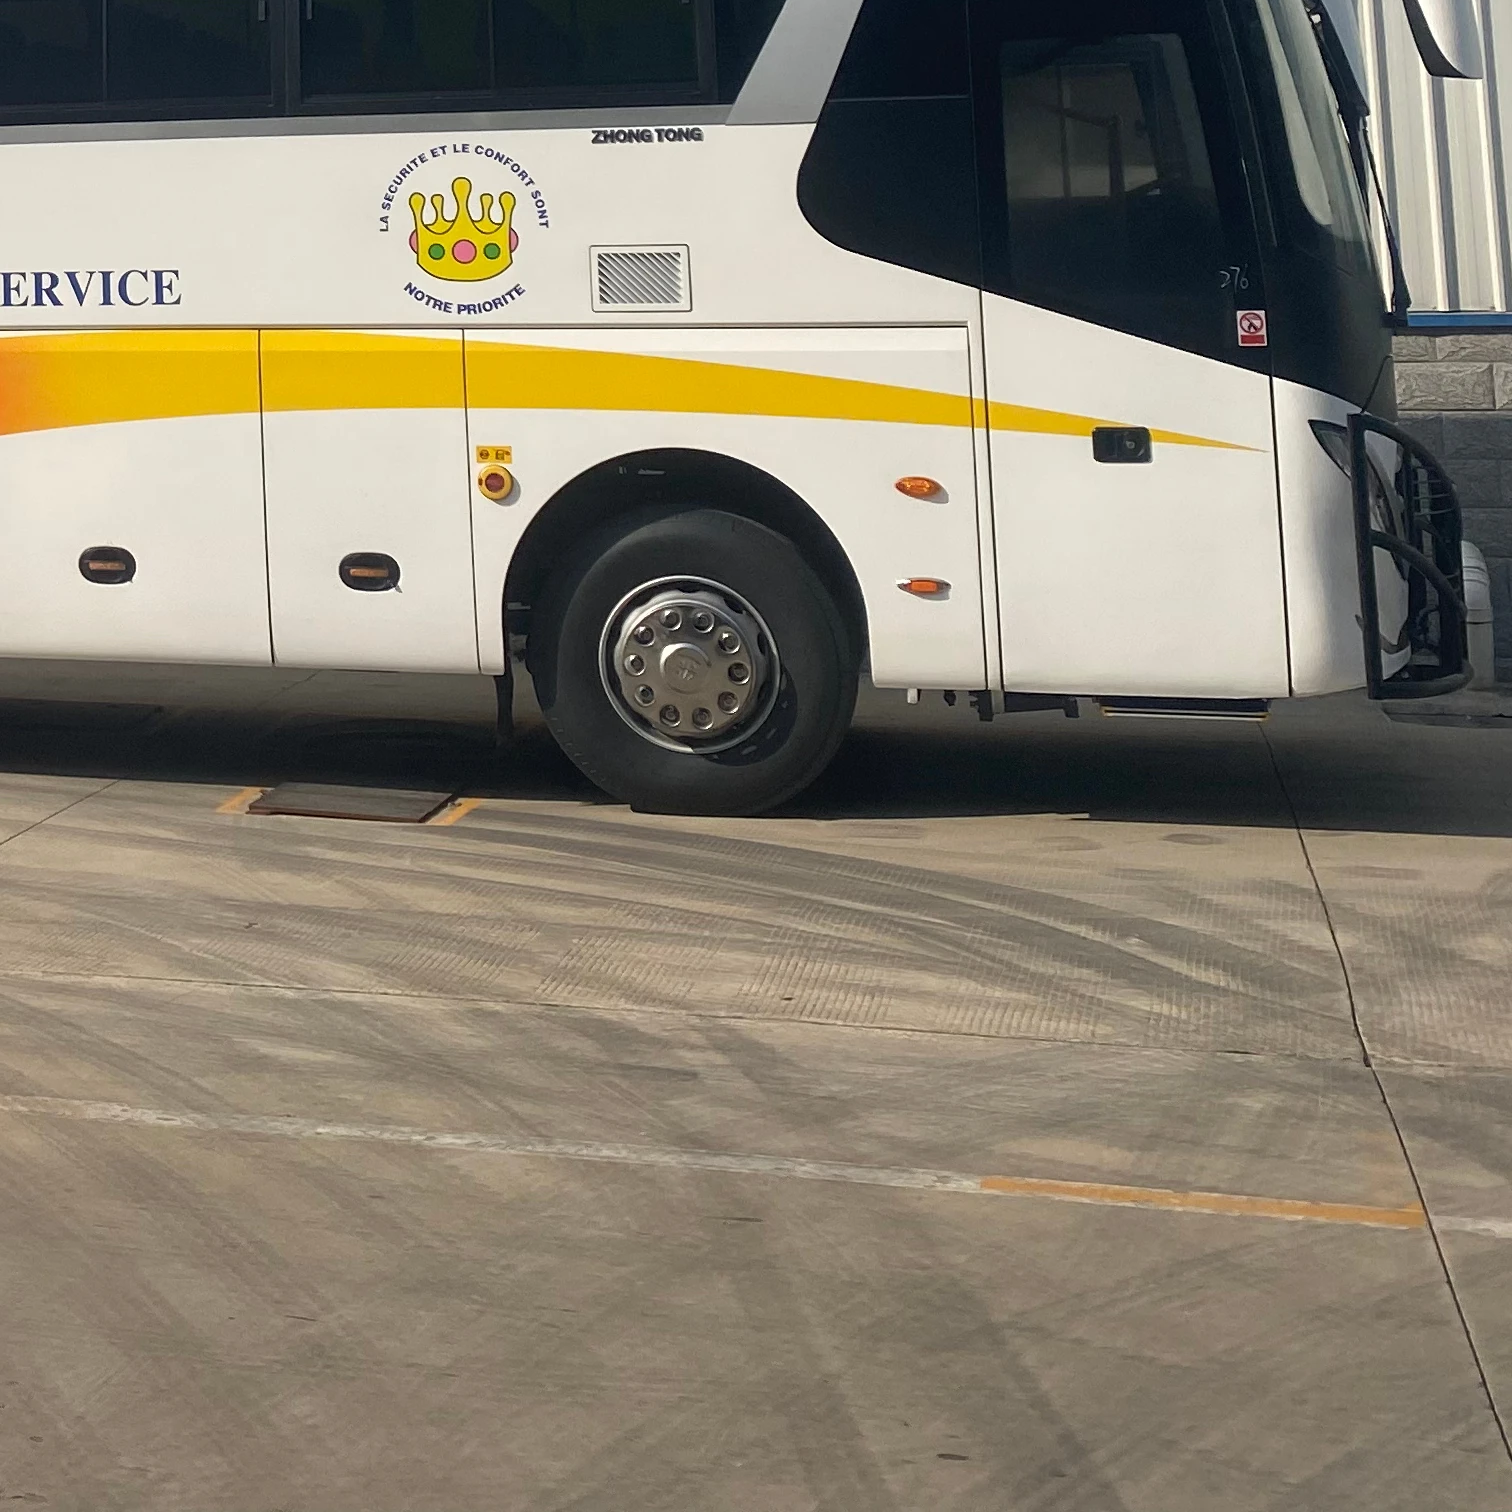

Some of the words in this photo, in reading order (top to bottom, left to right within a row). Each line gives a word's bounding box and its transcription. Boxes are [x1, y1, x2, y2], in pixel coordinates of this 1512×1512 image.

[453, 143, 470, 153] LE
[591, 129, 654, 144] ZHONG
[655, 127, 704, 142] TONG
[430, 145, 448, 158] ET
[474, 144, 535, 187] CONFORT
[381, 152, 429, 210] SECURITE
[531, 190, 549, 228] SONT
[379, 215, 389, 232] LA
[403, 281, 453, 314] NOTRE
[457, 283, 526, 315] PRIORITE
